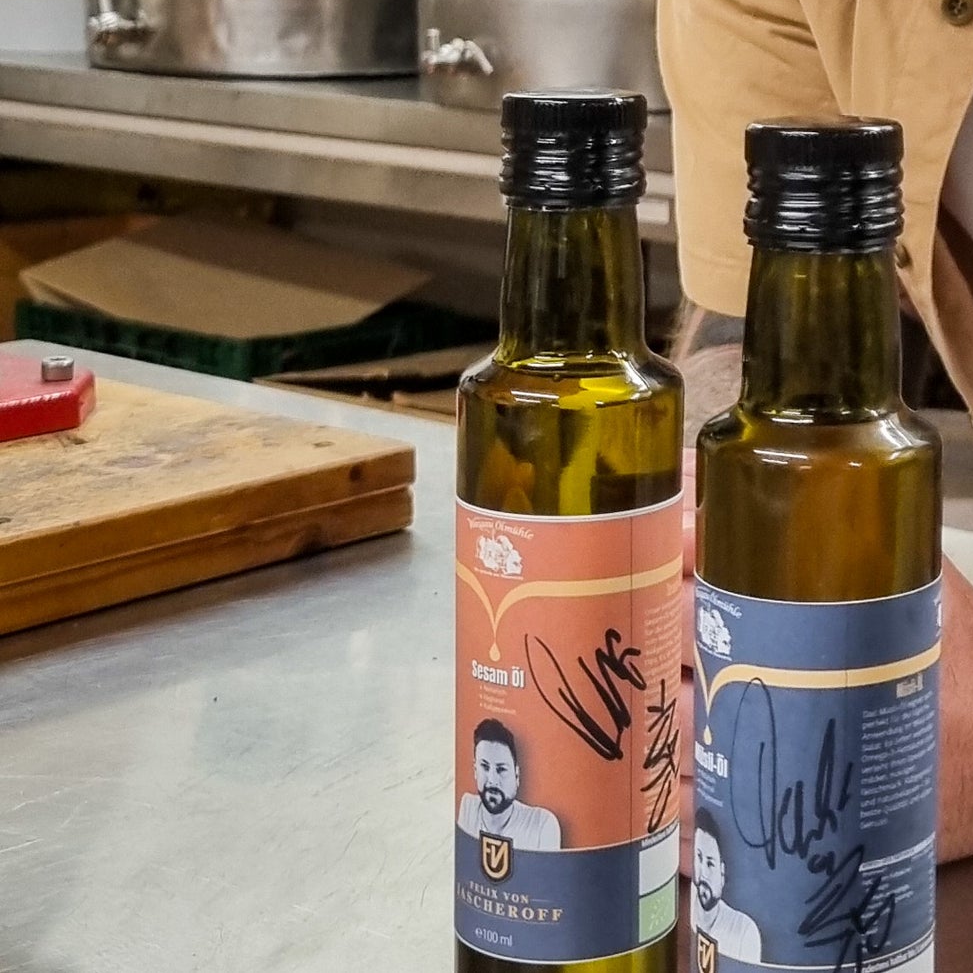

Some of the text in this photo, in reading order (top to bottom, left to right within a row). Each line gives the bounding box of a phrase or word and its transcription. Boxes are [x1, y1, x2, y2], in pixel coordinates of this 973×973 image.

[471, 658, 525, 688] Sesam Öl
[470, 880, 529, 904] FELIX VON
